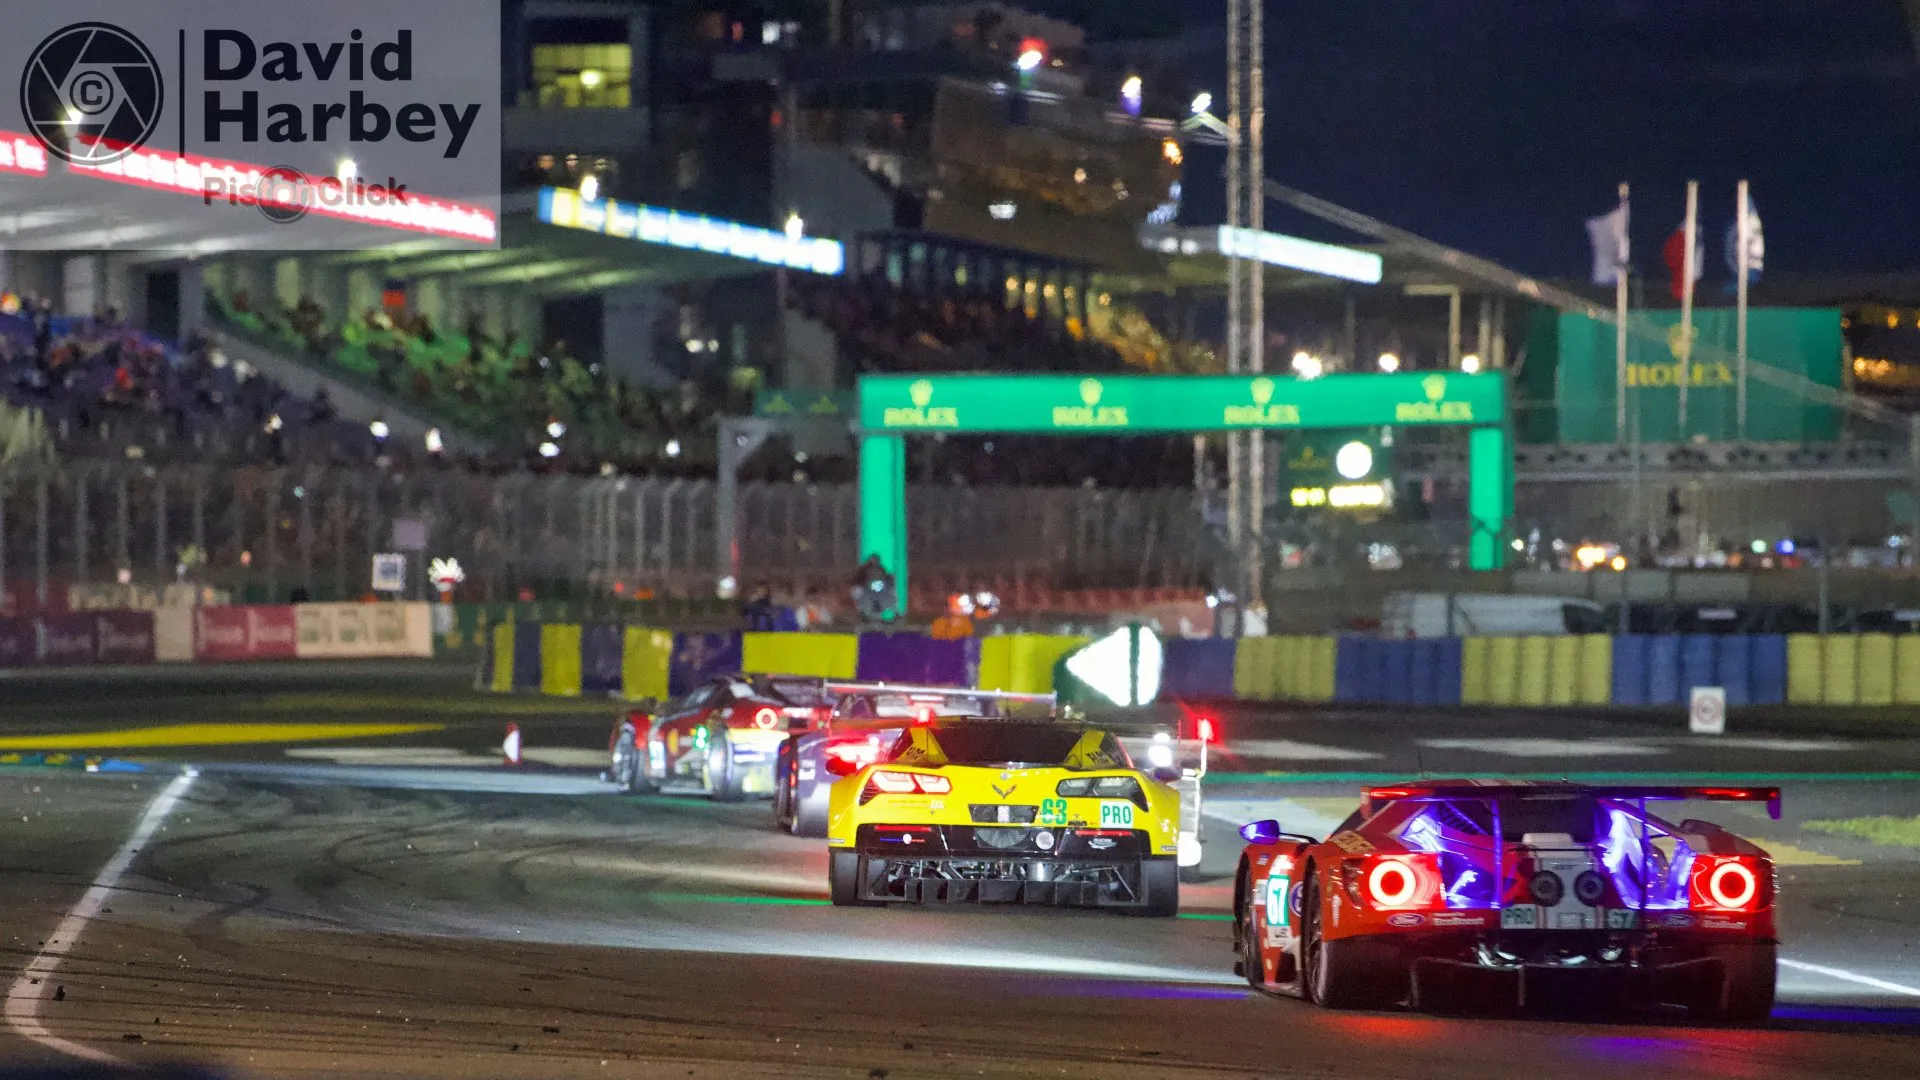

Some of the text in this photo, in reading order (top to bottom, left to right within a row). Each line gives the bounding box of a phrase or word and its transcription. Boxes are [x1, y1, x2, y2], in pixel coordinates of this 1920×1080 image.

[1042, 798, 1067, 825] 63
[1102, 805, 1132, 824] PRO
[1267, 878, 1290, 925] 67
[1503, 907, 1533, 925] PRO
[1607, 909, 1636, 928] 67
